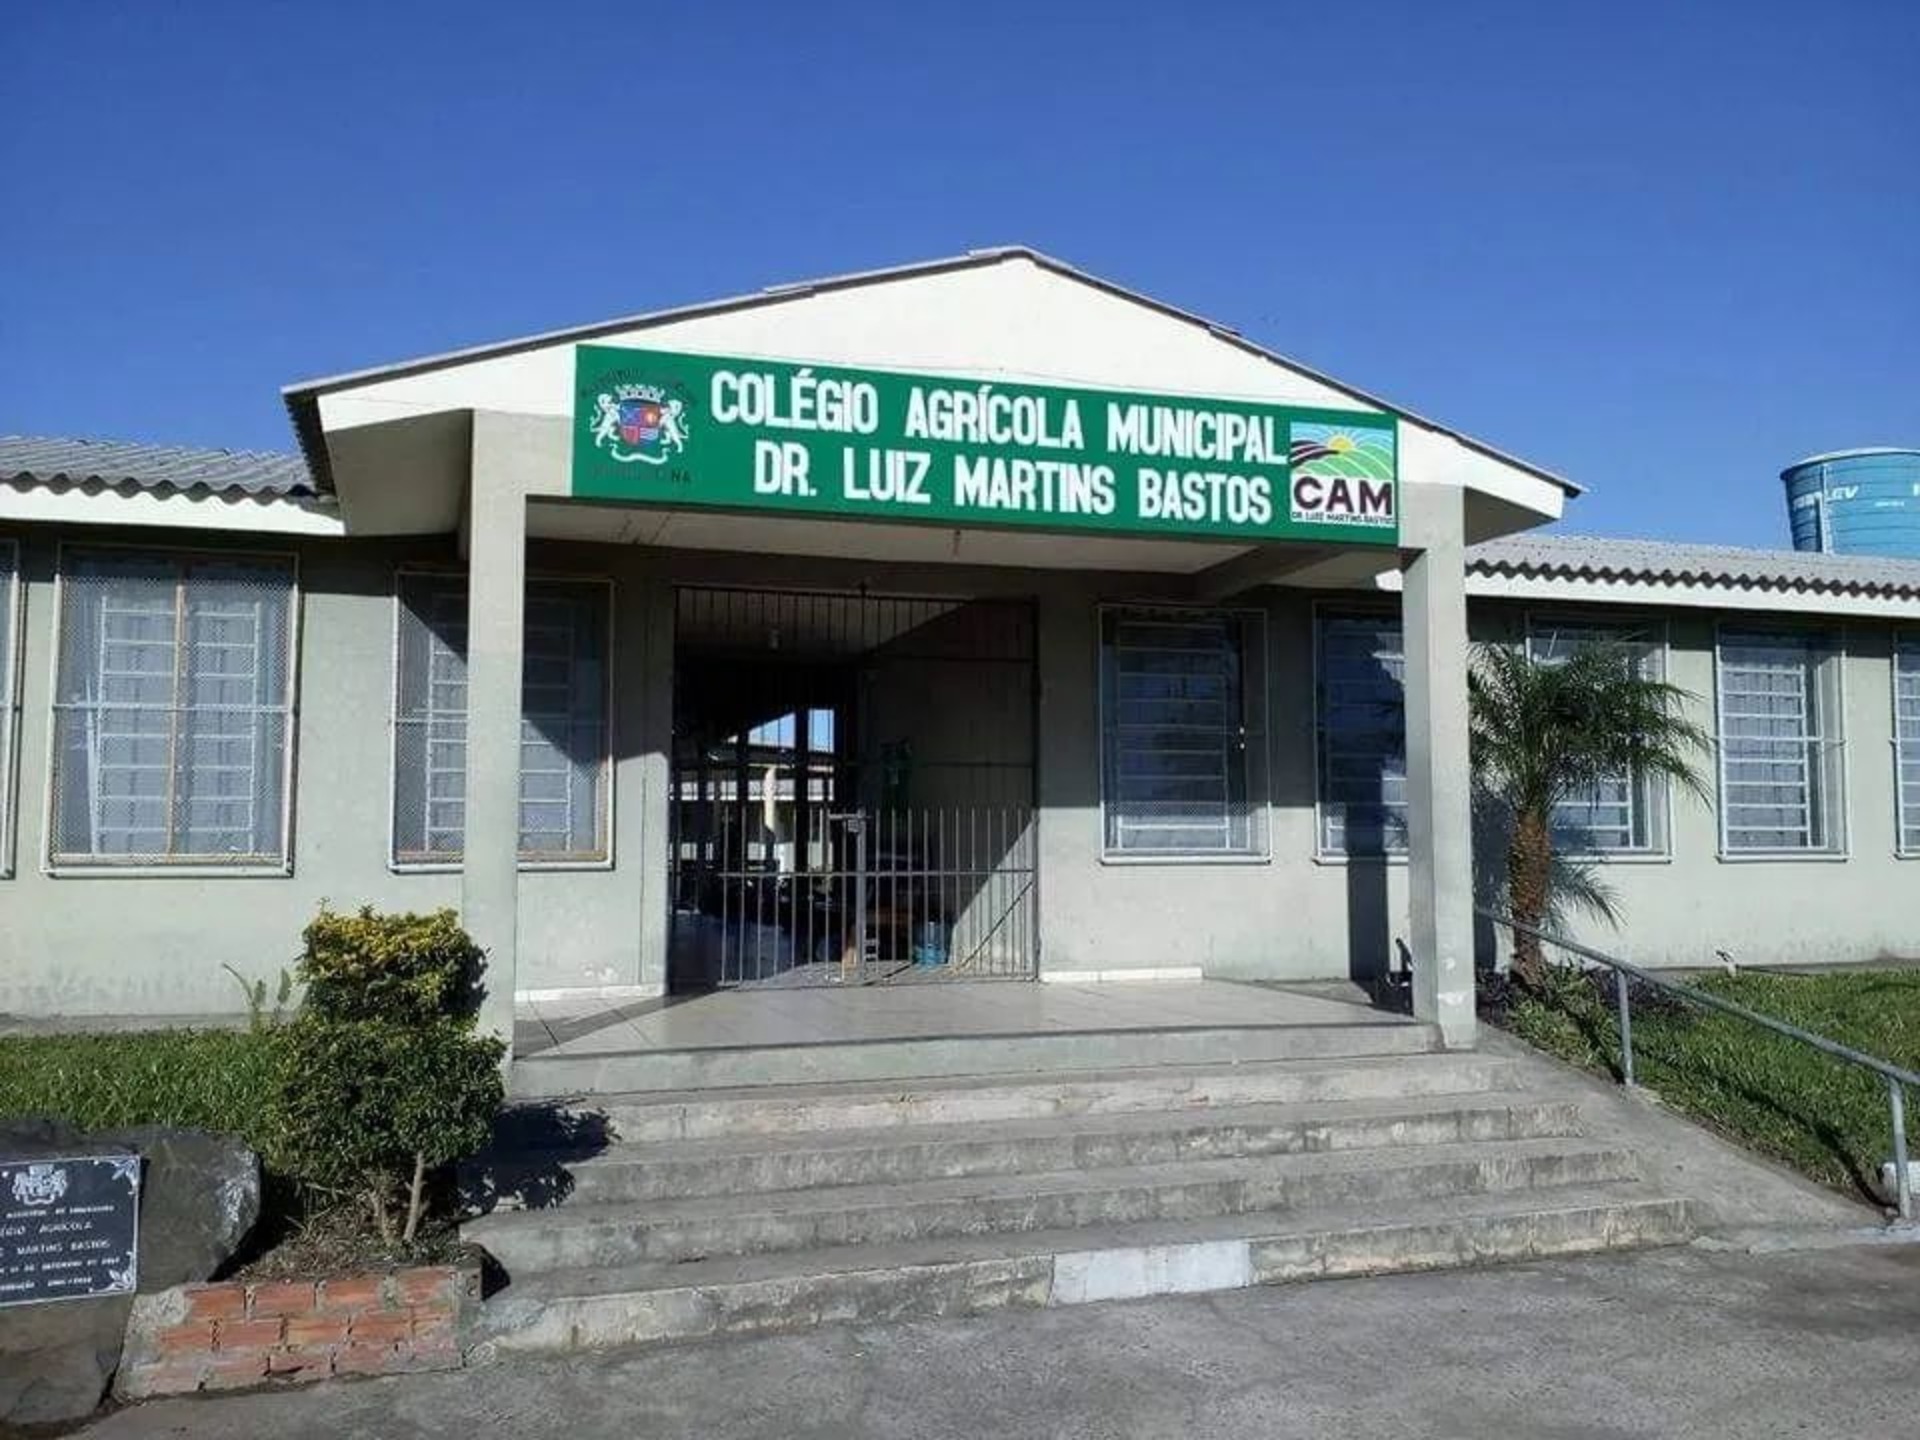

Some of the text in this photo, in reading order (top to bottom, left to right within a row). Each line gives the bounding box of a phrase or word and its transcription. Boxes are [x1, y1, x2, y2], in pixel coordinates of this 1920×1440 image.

[711, 367, 879, 434] COLÉGIO
[905, 384, 1084, 450] AGRÍCOLA
[1107, 402, 1288, 465] MUNICIPAL
[754, 440, 1272, 524] DR. LUIZ MARTINS BASTOS
[1294, 476, 1393, 515] CAM
